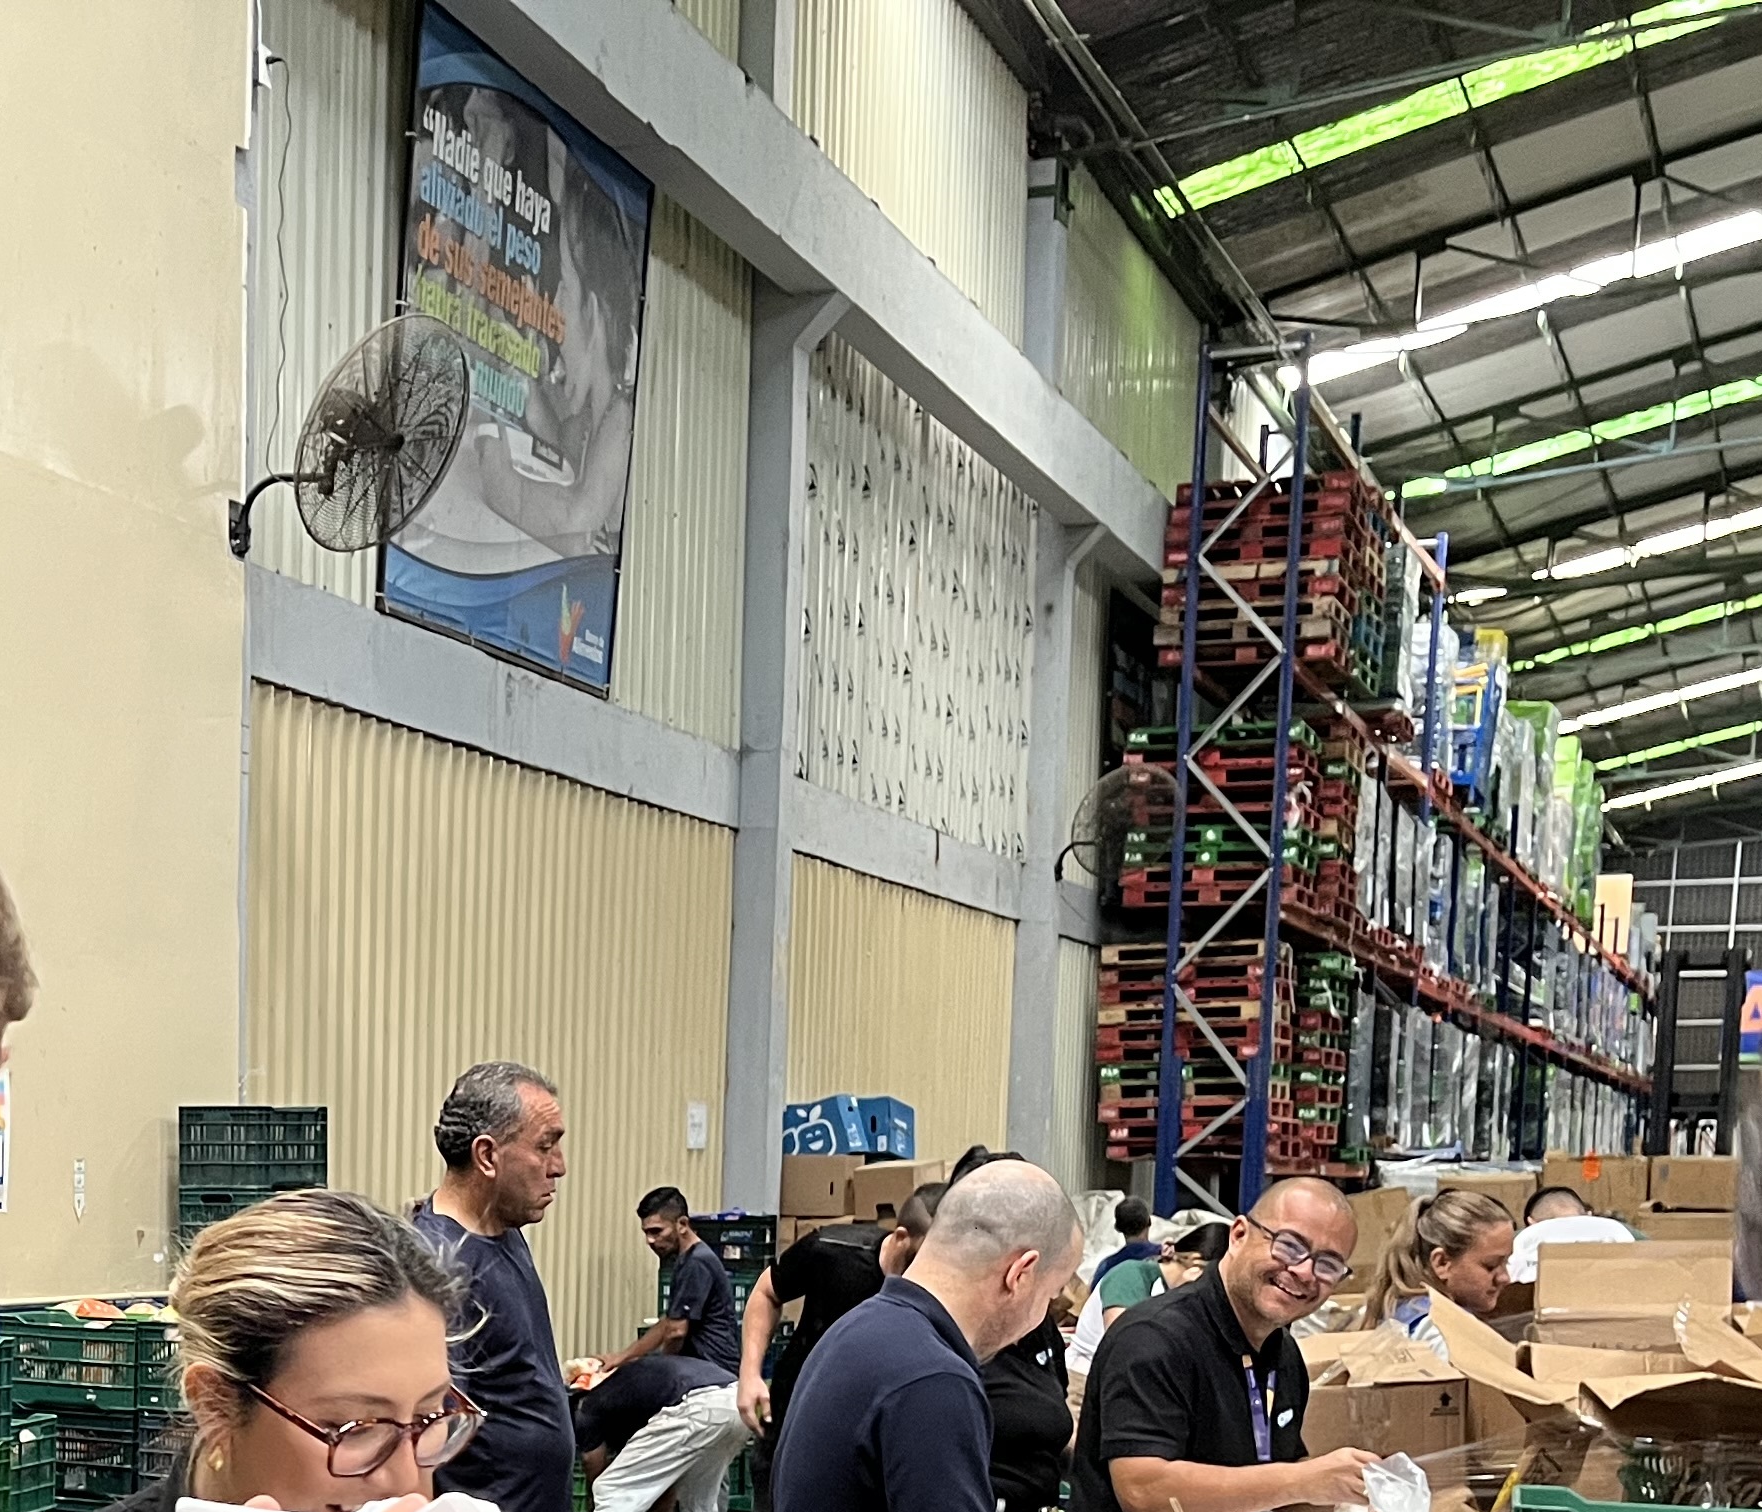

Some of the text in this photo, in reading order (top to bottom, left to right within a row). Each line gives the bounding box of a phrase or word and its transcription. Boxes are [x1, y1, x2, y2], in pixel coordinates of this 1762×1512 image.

[483, 157, 513, 207] que
[515, 169, 551, 236] haya
[418, 212, 566, 345] de sus semejantes
[488, 205, 503, 250] el
[505, 222, 541, 275] peso
